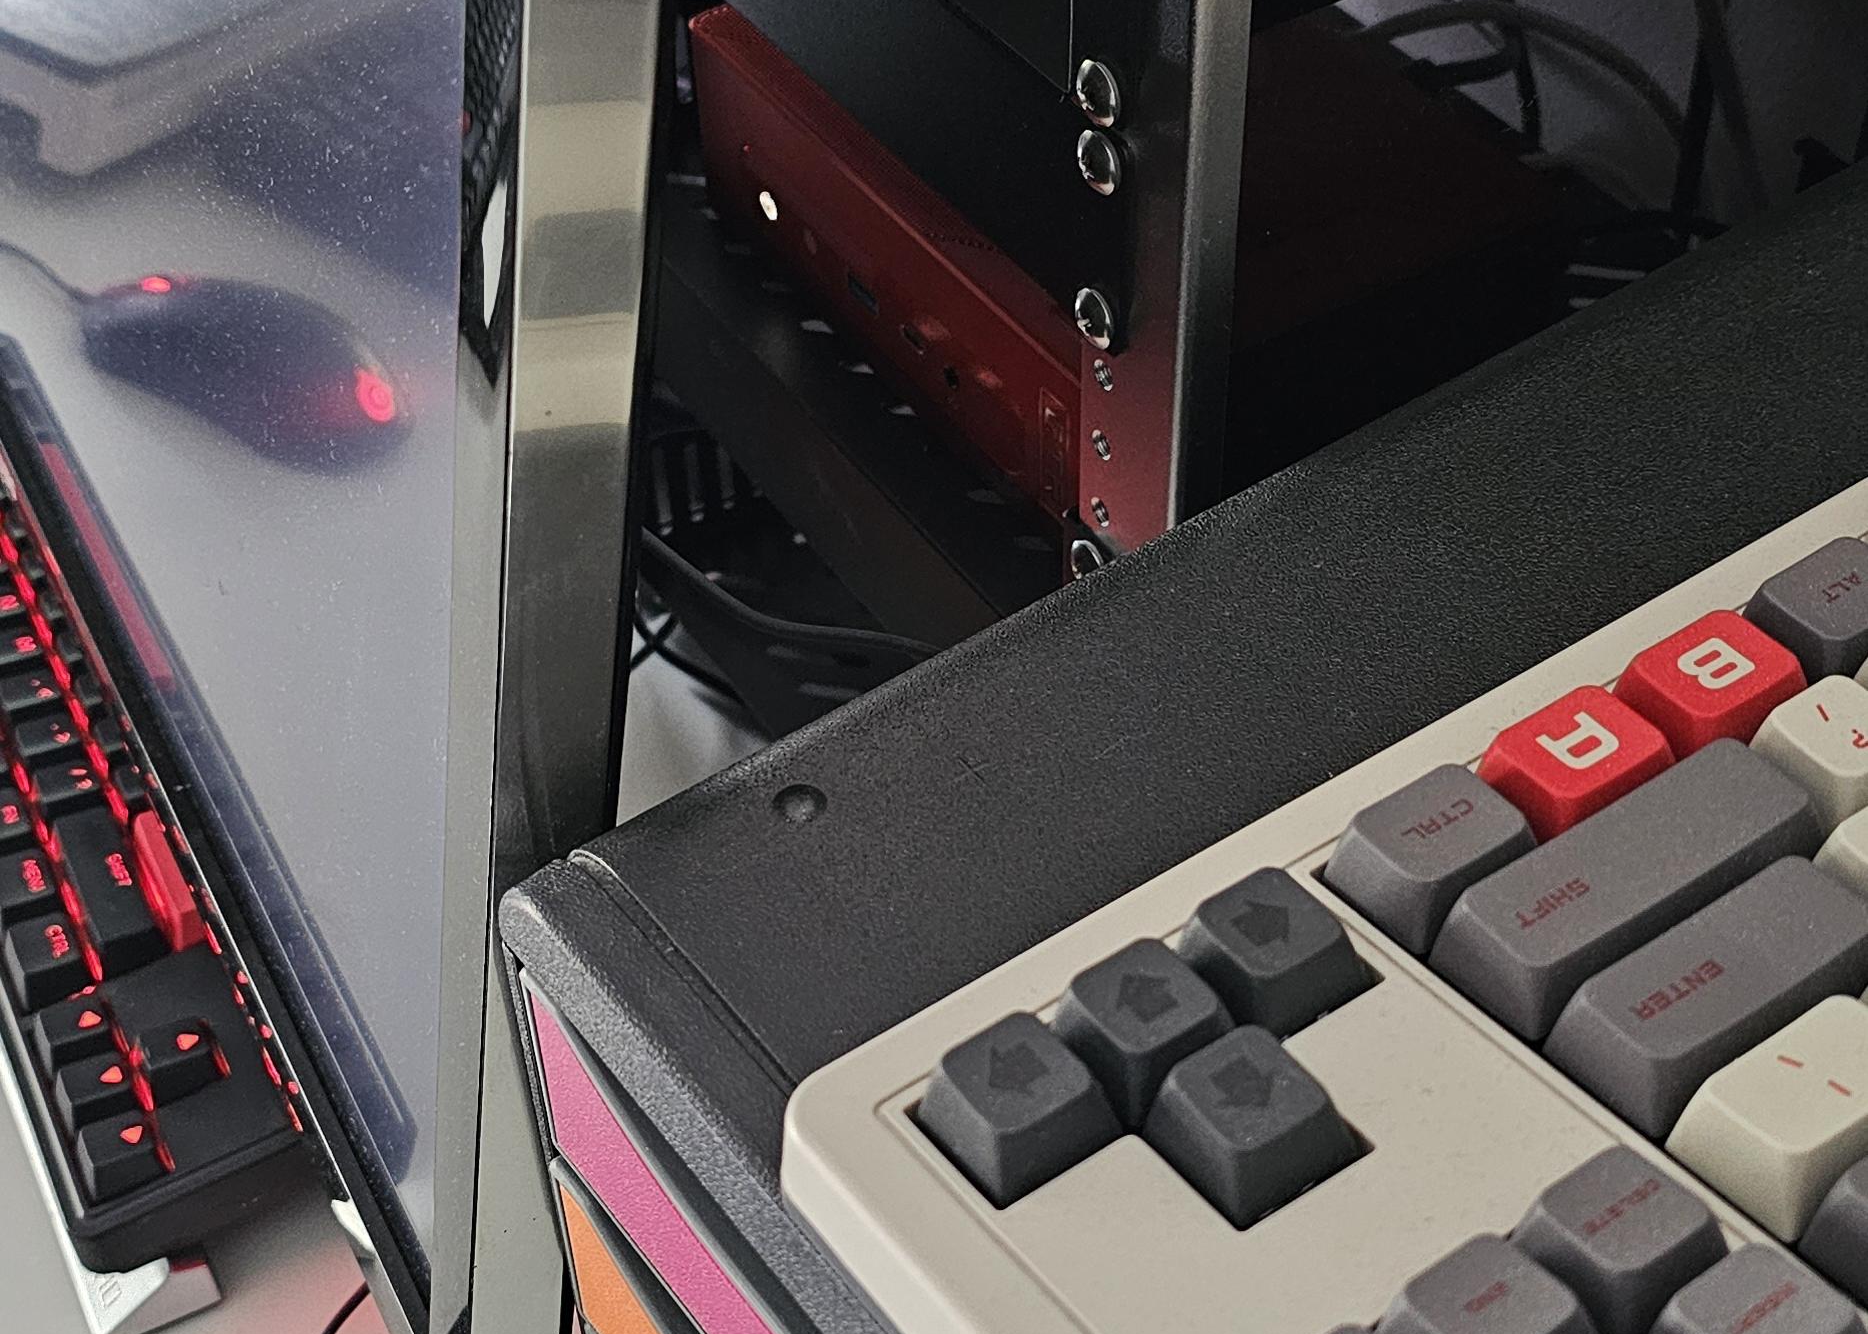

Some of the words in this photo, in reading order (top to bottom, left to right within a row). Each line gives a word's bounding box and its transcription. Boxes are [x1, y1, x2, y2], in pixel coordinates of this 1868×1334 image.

[1822, 571, 1862, 604] ALT
[1676, 637, 1757, 690] B
[1535, 711, 1621, 770] A
[1401, 798, 1475, 840] CTRL
[1516, 877, 1591, 930] SHIFT
[1635, 959, 1725, 1022] ENTER
